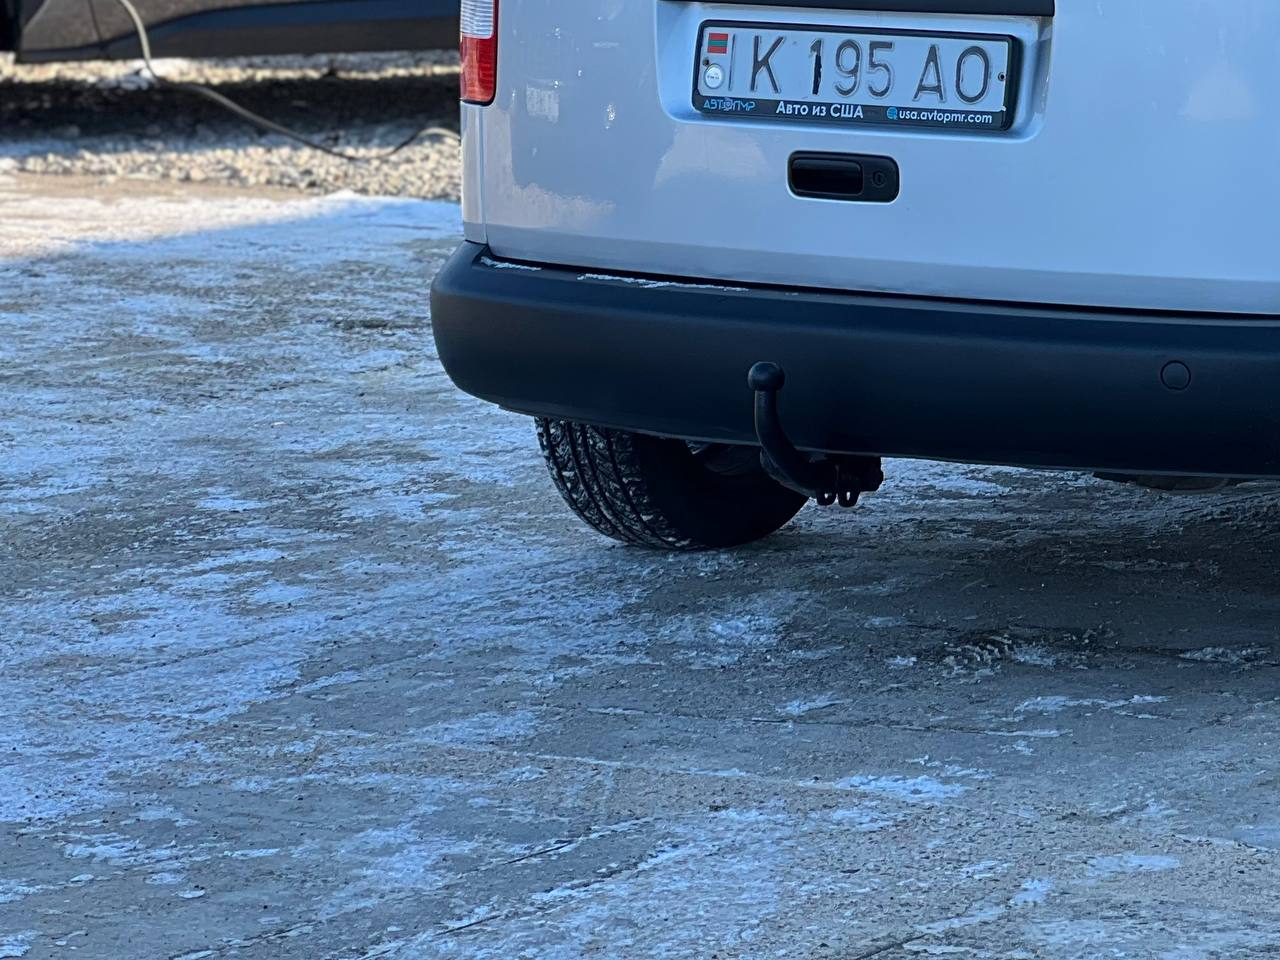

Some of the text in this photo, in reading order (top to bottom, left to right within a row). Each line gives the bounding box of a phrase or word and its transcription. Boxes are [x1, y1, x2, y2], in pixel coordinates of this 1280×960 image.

[808, 38, 896, 100] 195
[812, 105, 827, 117] из
[830, 103, 864, 119] США
[899, 109, 993, 124] usa.avtopmr.com
